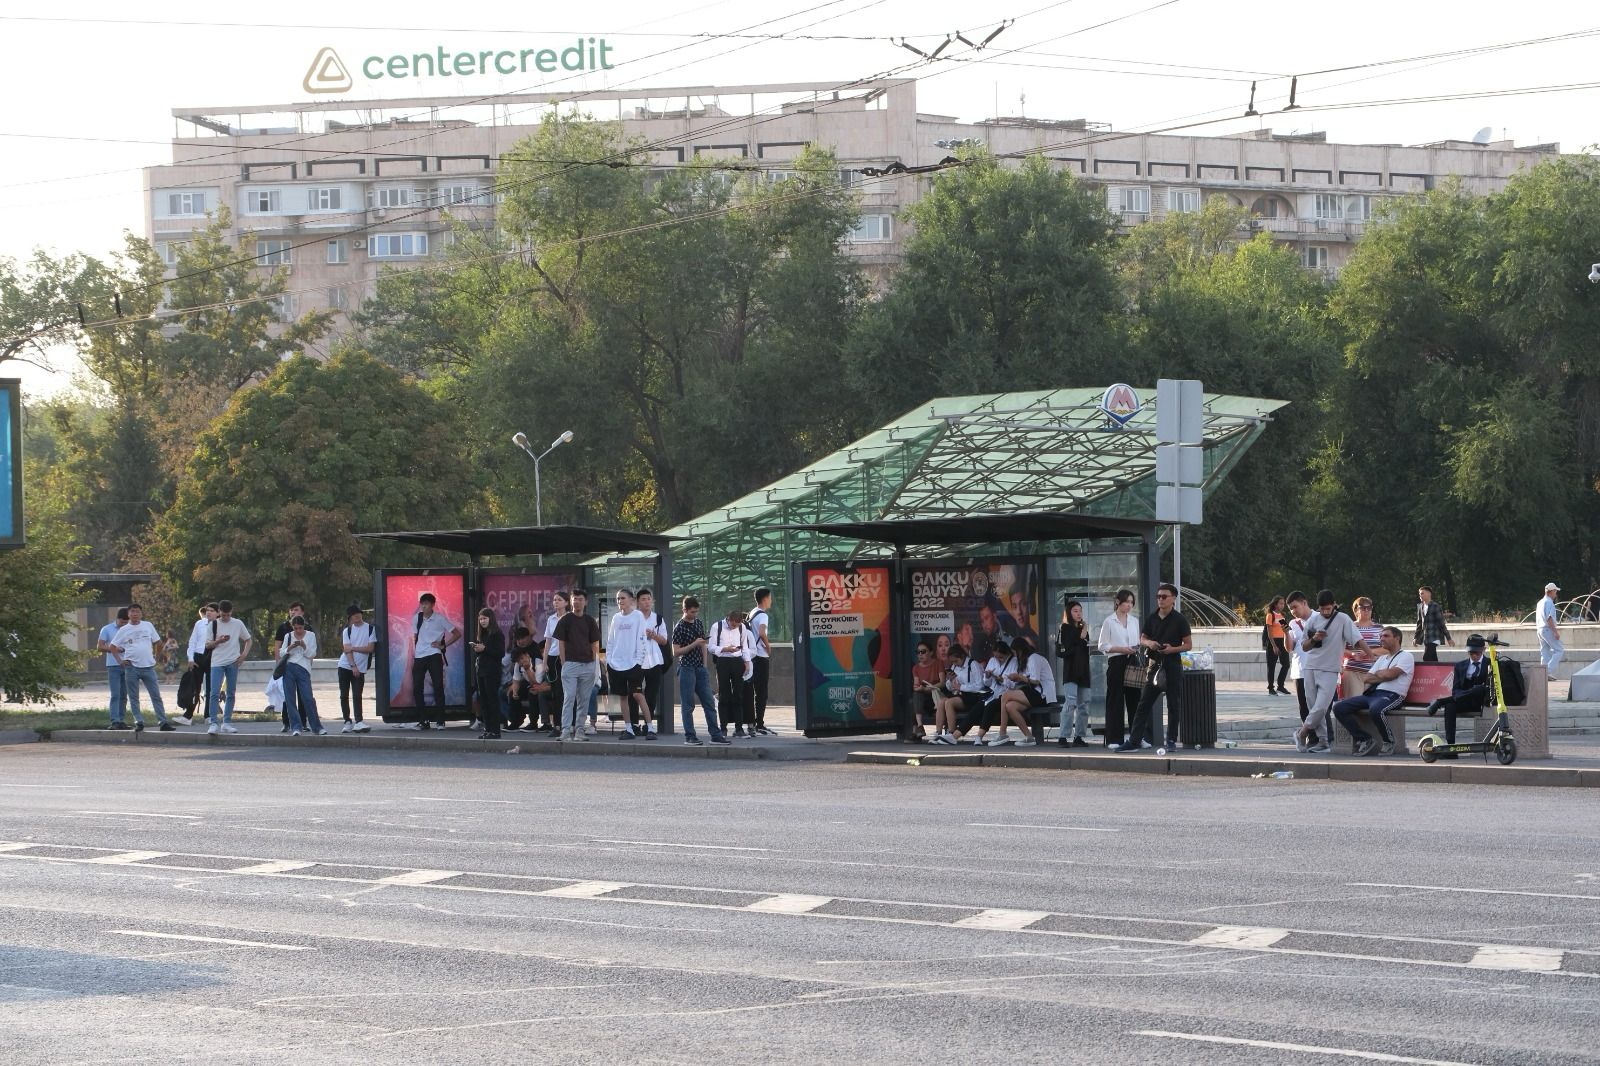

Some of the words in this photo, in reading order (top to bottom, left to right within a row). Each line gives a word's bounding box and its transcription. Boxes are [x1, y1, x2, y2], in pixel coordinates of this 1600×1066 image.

[362, 37, 614, 80] centercredit
[810, 586, 881, 601] DAUYSY
[912, 584, 968, 598] DAUYSY
[810, 599, 852, 612] 2022
[913, 597, 945, 608] 2022
